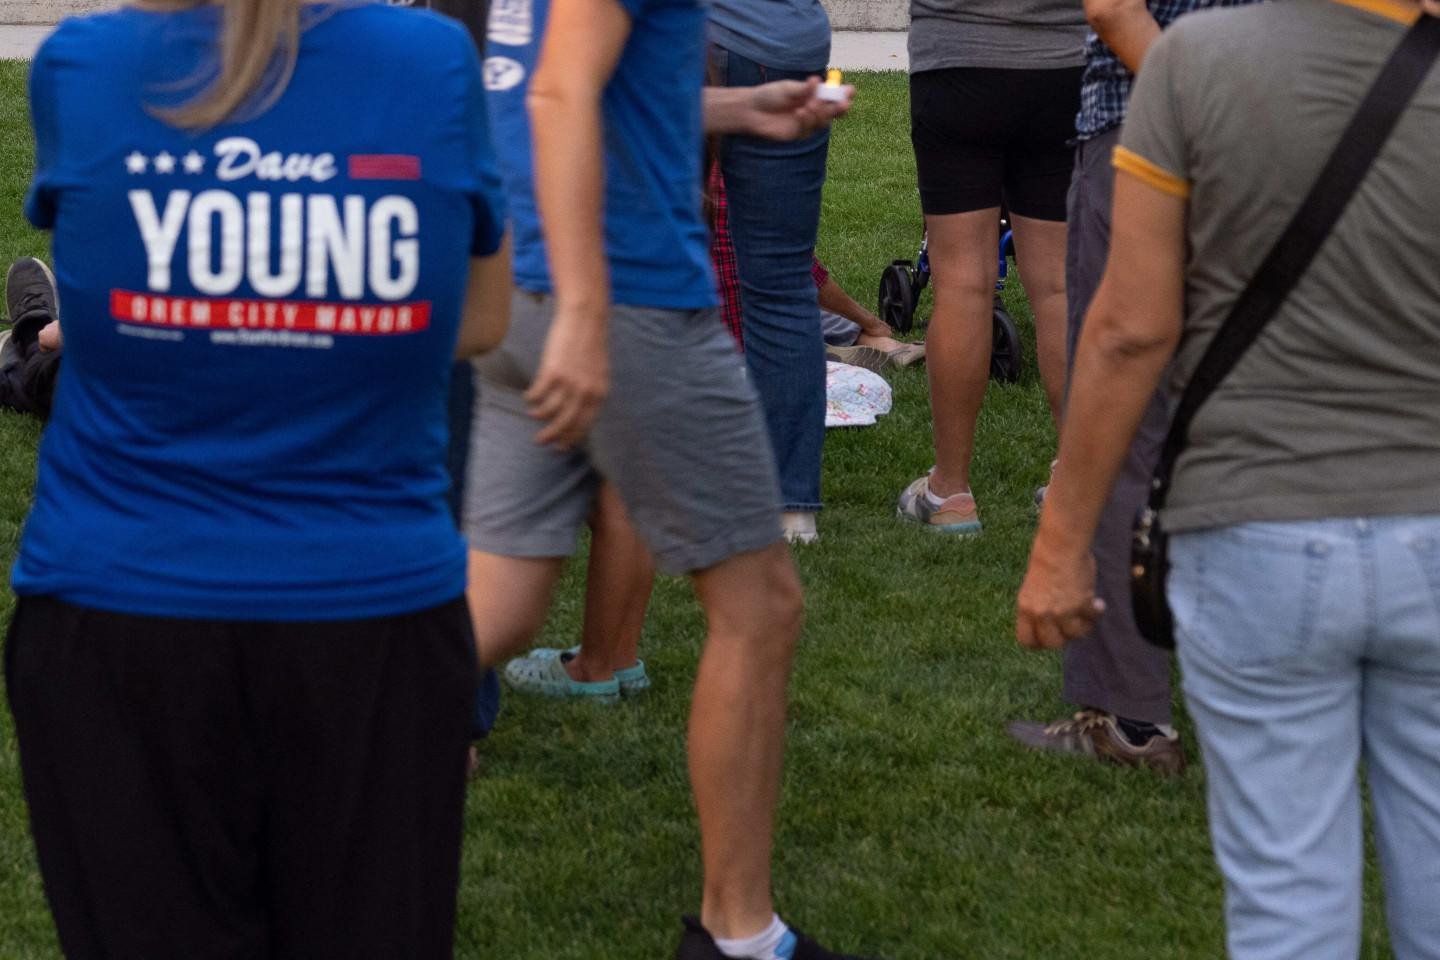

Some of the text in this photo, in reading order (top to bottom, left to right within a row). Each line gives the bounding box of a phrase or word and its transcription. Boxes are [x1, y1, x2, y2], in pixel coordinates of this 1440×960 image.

[213, 136, 337, 182] Dave
[127, 188, 420, 301] YOUNG
[227, 301, 299, 327] CITY
[314, 305, 413, 332] MAYOR
